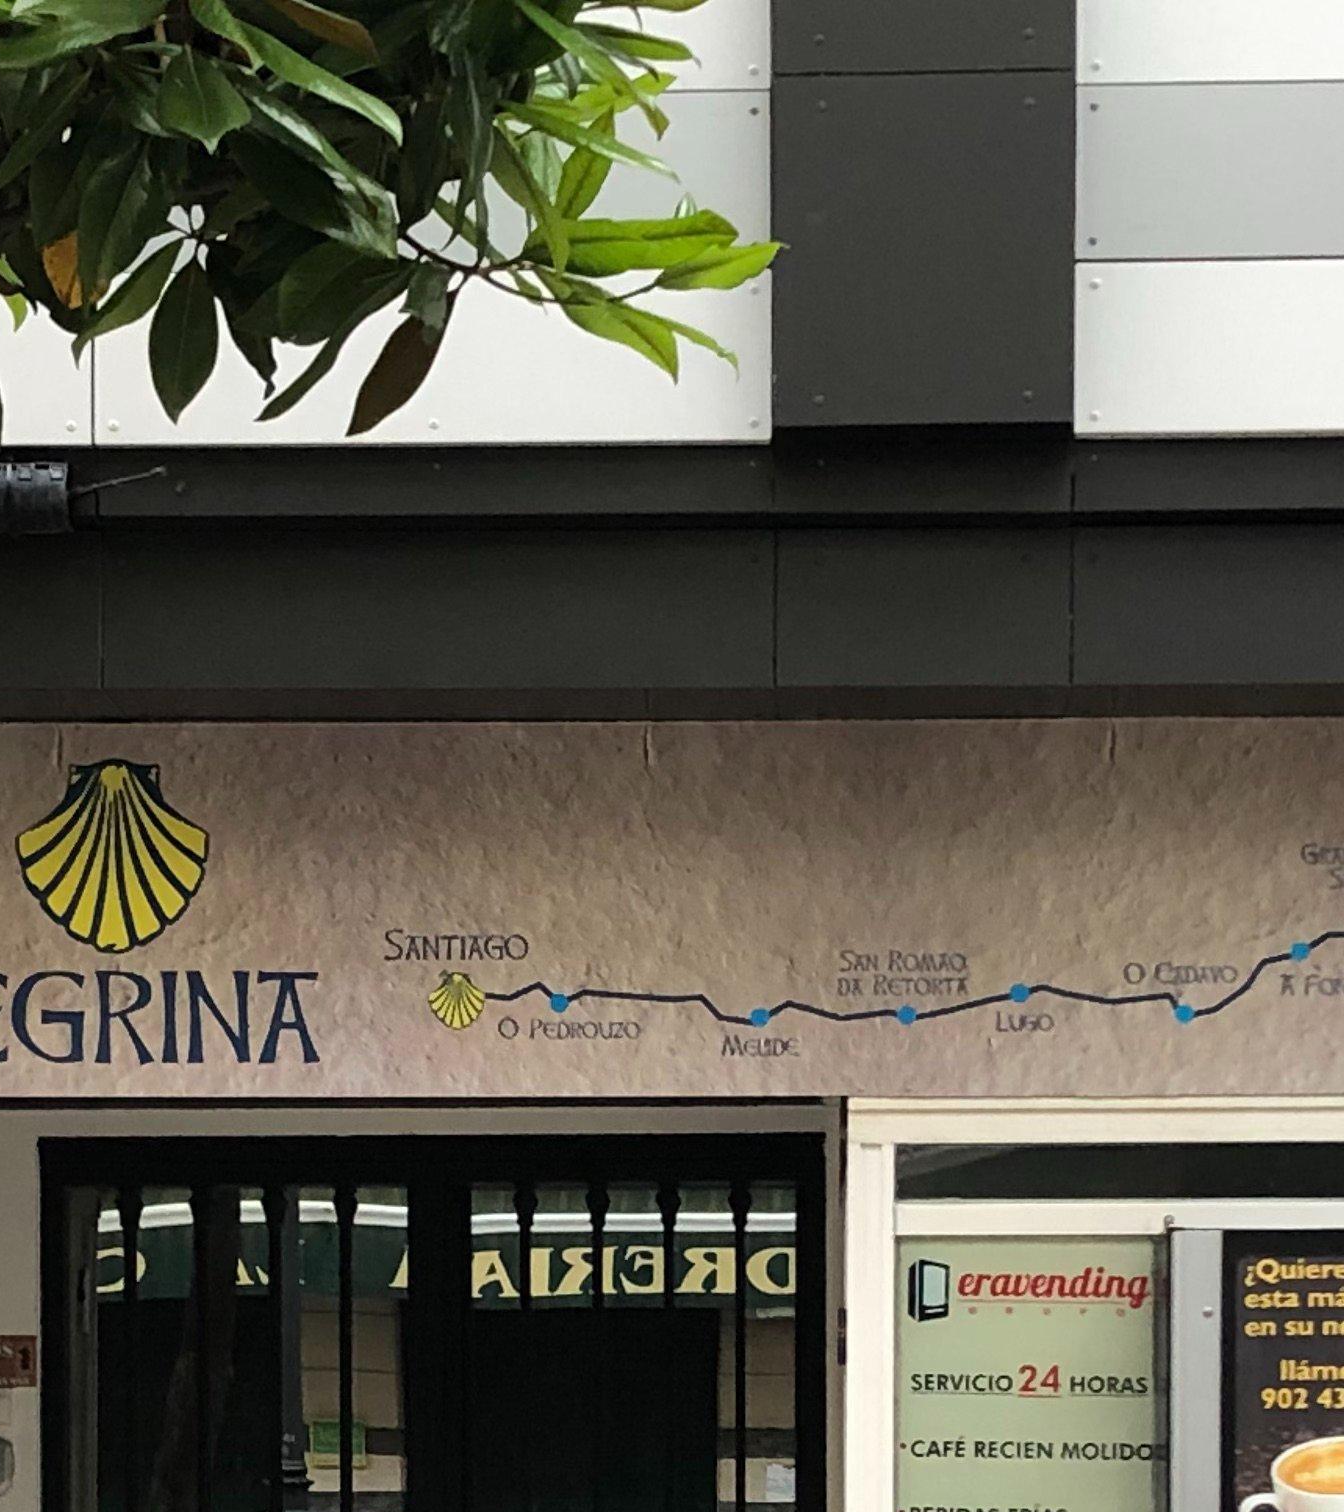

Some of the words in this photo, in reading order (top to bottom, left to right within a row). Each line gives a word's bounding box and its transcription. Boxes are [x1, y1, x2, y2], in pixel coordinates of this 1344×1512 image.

[384, 928, 530, 961] SANTIAGO
[839, 950, 879, 972] SAN
[1123, 961, 1147, 984] O
[497, 1016, 520, 1040] O
[529, 1017, 641, 1040] PEDROUZO
[995, 1011, 1055, 1033] LUGO
[958, 1266, 1151, 1309] eravending
[1244, 1291, 1300, 1308] esta
[1244, 1321, 1277, 1337] en
[1285, 1321, 1314, 1336] su
[910, 1373, 1014, 1394] SERVICIO
[1017, 1365, 1061, 1394] 24
[1070, 1375, 1149, 1394] HORAS
[1261, 1387, 1309, 1410] 902
[911, 1436, 966, 1459] CAFÉ
[974, 1440, 1054, 1460] RECIEN
[1060, 1441, 1153, 1461] MOLIDO
